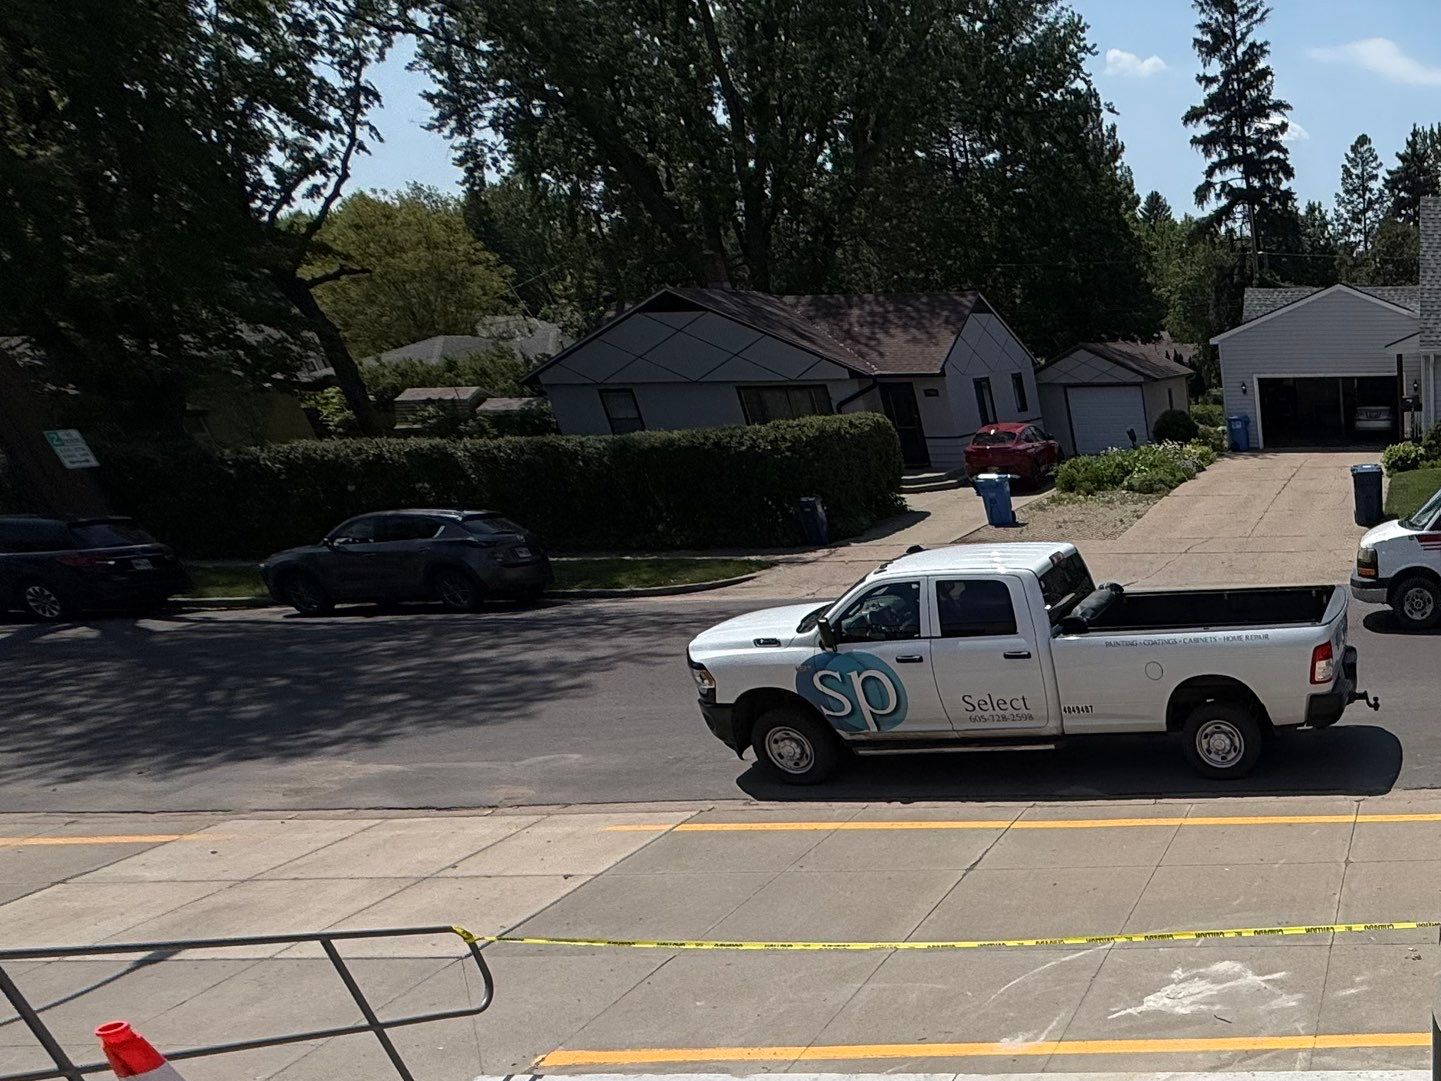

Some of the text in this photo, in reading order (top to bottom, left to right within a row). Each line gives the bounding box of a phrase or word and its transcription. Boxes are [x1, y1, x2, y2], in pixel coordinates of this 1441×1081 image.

[1223, 634, 1244, 642] HOME
[1245, 633, 1270, 641] REPAIR
[813, 669, 897, 732] sp
[961, 693, 1030, 712] Select
